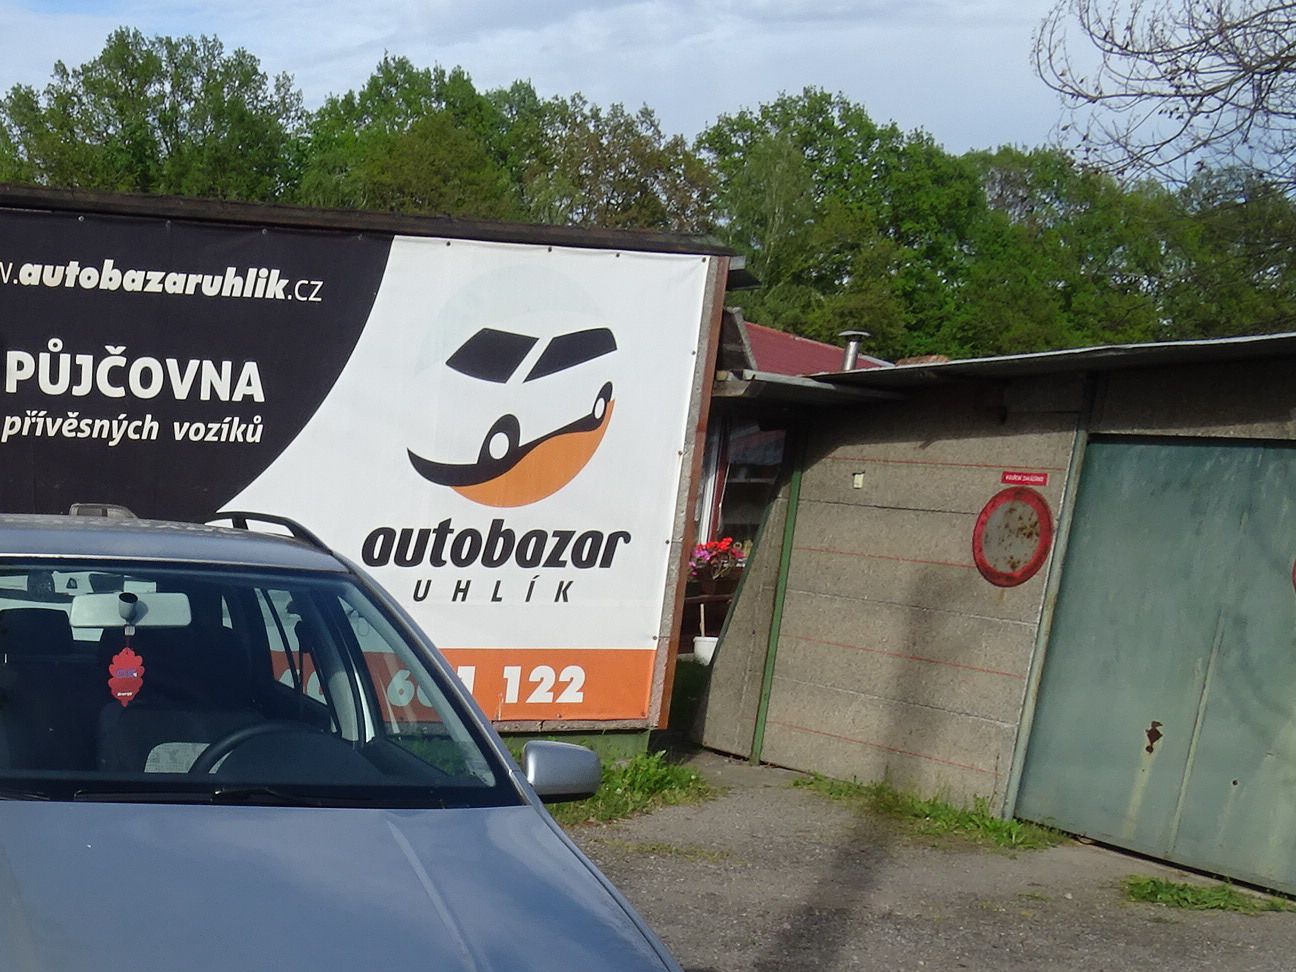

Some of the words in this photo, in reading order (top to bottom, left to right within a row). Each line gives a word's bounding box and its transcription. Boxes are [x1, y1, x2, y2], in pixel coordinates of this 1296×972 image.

[5, 337, 265, 403] PŮJČOVNA
[1, 409, 160, 446] přívěsných
[173, 414, 264, 443] vozíků
[361, 518, 632, 568] autobazar
[412, 574, 574, 602] UHLÍK
[503, 665, 586, 704] 122
